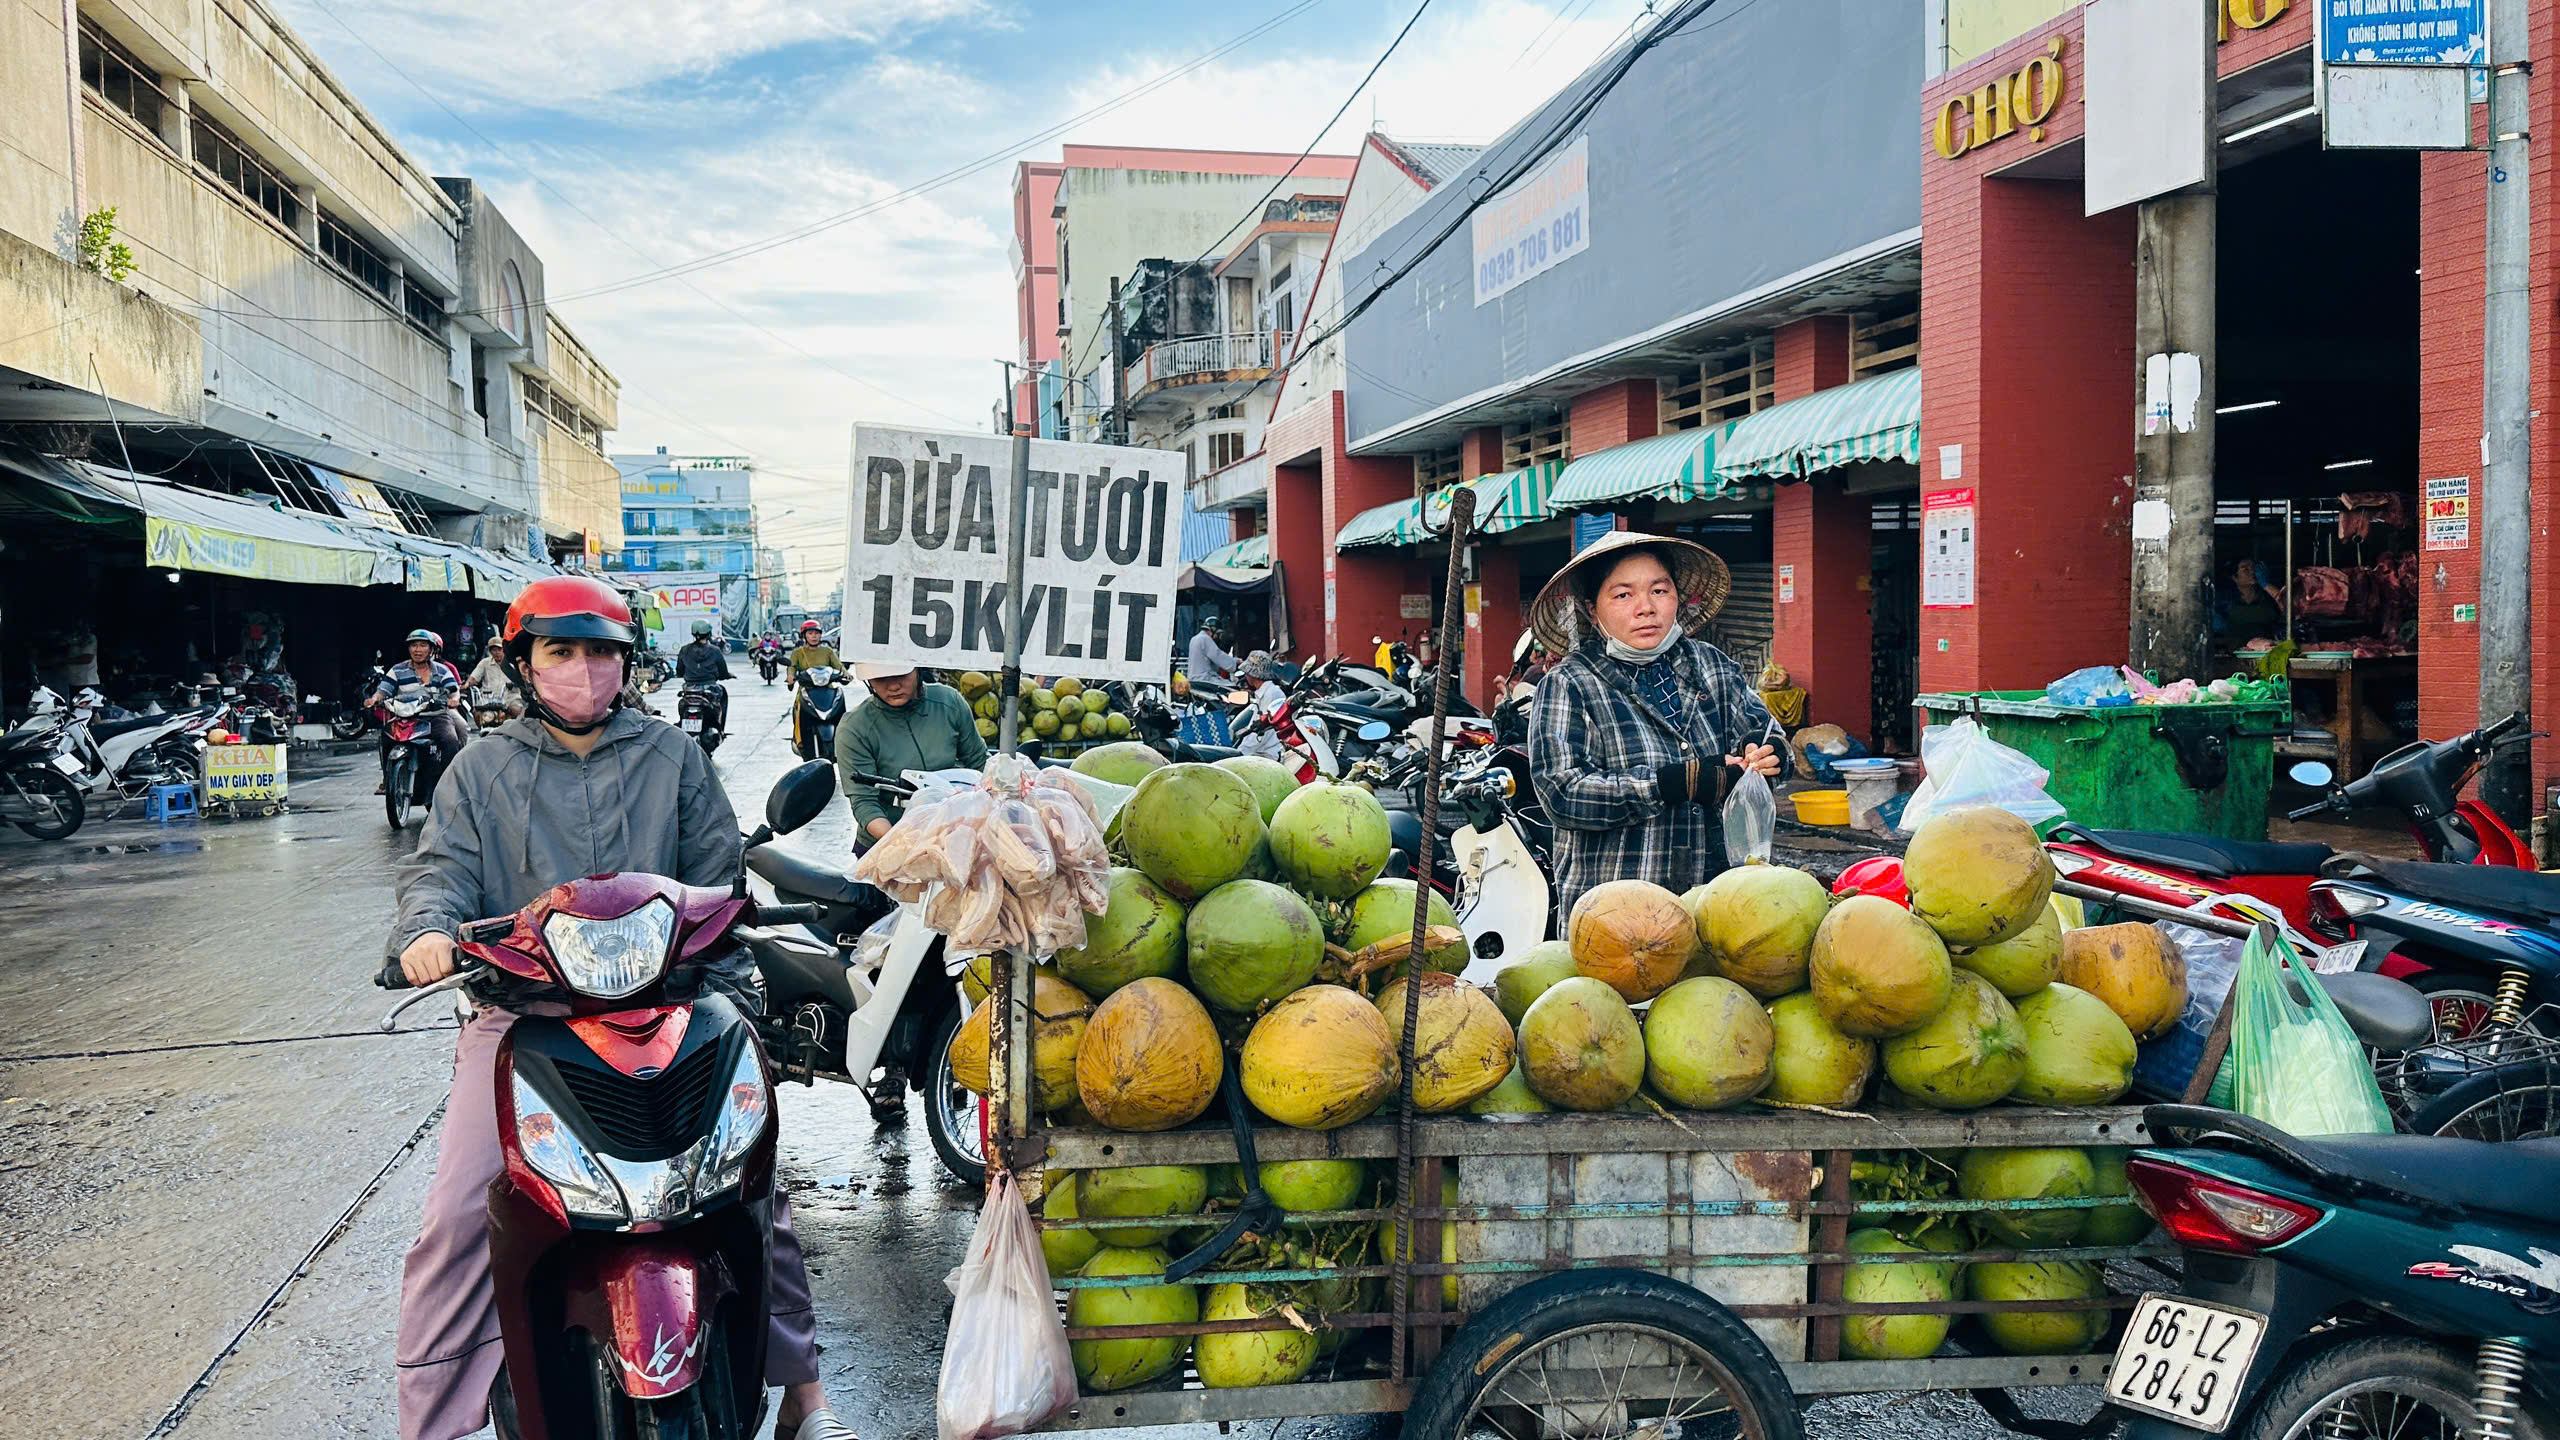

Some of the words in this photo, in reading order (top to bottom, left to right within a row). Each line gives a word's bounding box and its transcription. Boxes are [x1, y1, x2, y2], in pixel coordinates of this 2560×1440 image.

[2347, 23, 2377, 43] KHÔNG
[2378, 21, 2401, 41] ĐÚNG
[2402, 21, 2417, 40] NƠI
[2419, 21, 2436, 40] QUY
[2437, 20, 2458, 41] ĐỊNH
[1934, 34, 2065, 160] CHỢ
[863, 440, 997, 554] DỪA
[1027, 466, 1169, 567] TƯƠI
[673, 588, 717, 606] APG
[212, 747, 271, 767] KHA
[210, 775, 230, 789] MAY
[2398, 901, 2485, 926] Wave
[2144, 1304, 2242, 1364] 66-L2
[2121, 1352, 2219, 1416] 2849
